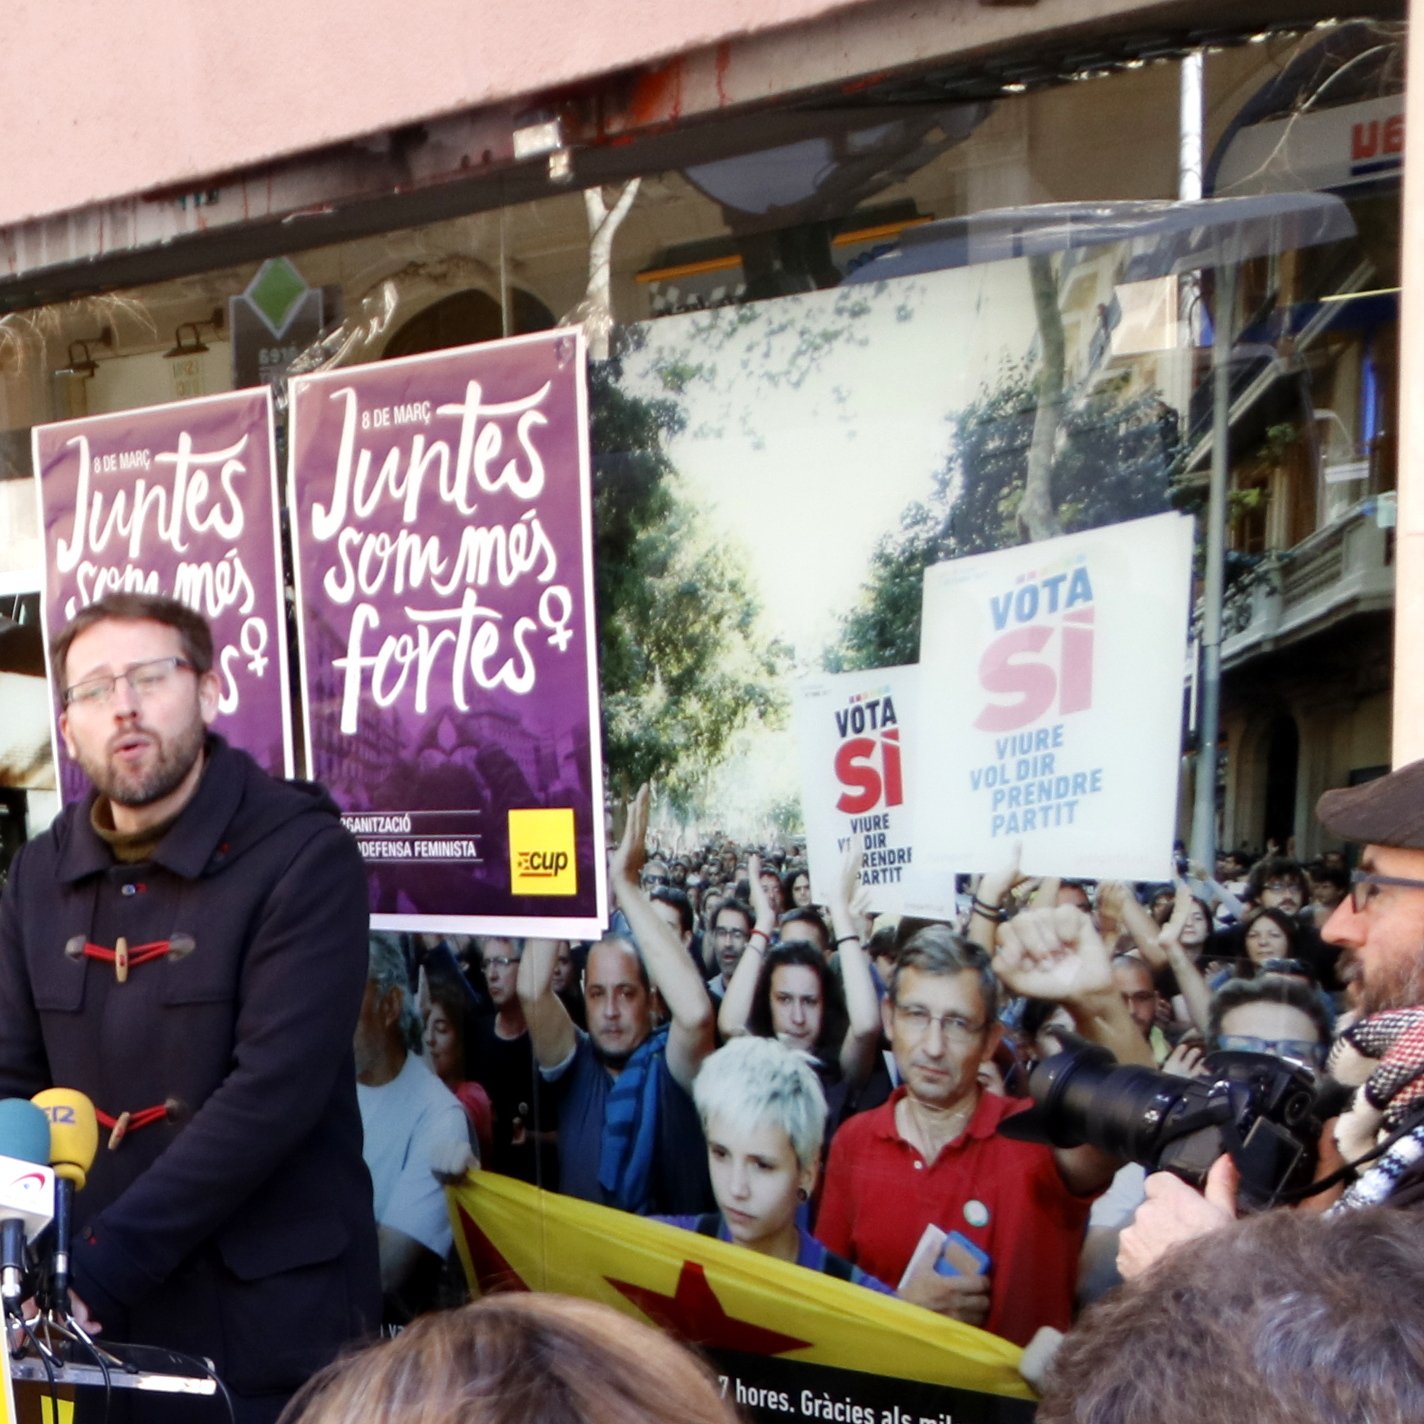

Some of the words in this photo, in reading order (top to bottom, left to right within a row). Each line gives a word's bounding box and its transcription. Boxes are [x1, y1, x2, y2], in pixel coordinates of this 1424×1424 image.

[361, 412, 371, 430] 8
[373, 408, 391, 427] DE
[394, 402, 432, 426] MARÇ
[94, 458, 101, 474] 8
[104, 454, 118, 472] DE
[119, 450, 151, 472] MARÇ
[312, 380, 551, 540] Juntes
[57, 432, 248, 573] Juntes
[324, 526, 448, 603] som
[431, 508, 557, 595] més
[332, 587, 537, 734] fortes
[996, 724, 1064, 760] VIURE
[970, 764, 1011, 791] VOL
[1016, 752, 1056, 782] DIR
[992, 768, 1103, 813] PRENDRE
[850, 812, 890, 834] VIURE
[991, 799, 1079, 838] PARTIT
[414, 839, 477, 858] FEMINISTA
[862, 846, 912, 868] RENDR
[864, 832, 887, 850] DIR
[528, 851, 568, 877] cup
[735, 1378, 795, 1413] hores.
